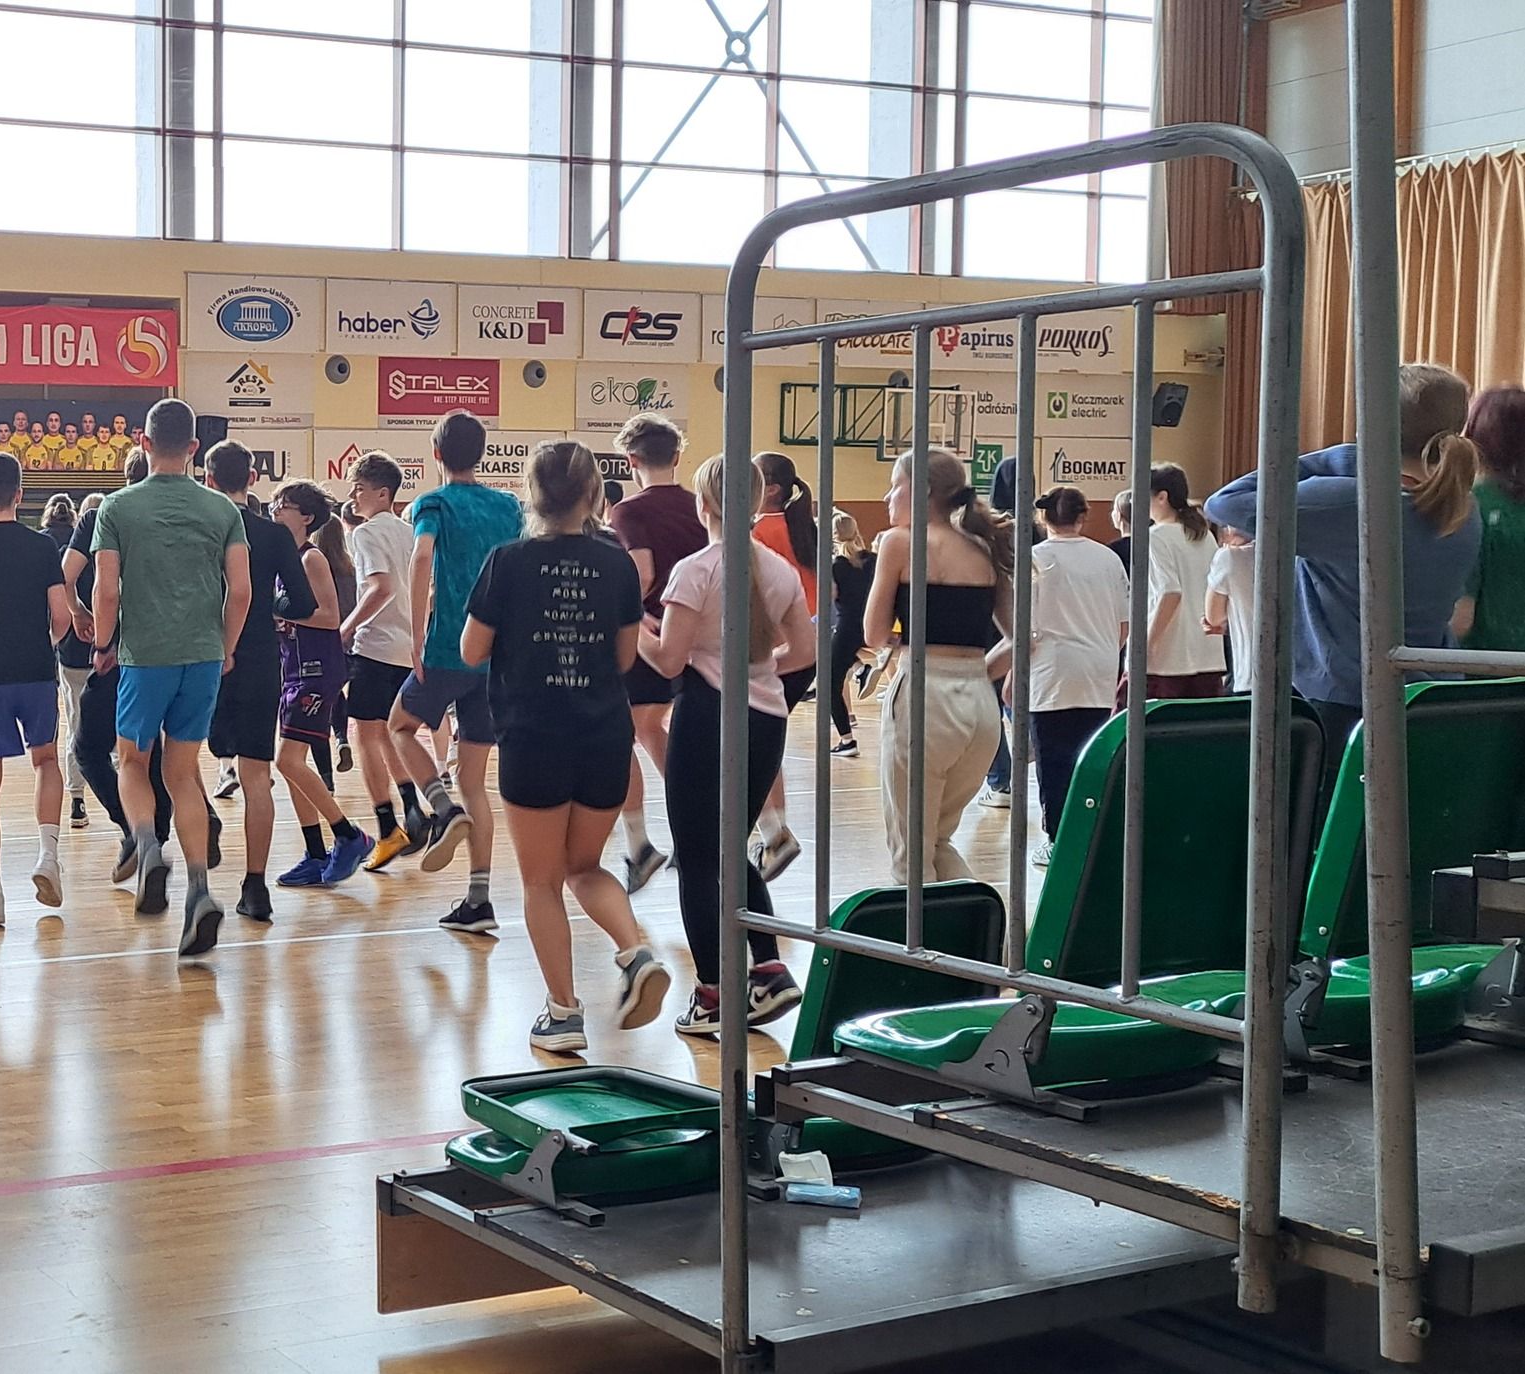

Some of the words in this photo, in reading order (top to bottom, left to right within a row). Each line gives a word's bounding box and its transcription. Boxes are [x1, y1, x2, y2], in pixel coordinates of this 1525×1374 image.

[472, 305, 536, 320] CONCRETE
[338, 310, 406, 333] haber
[600, 311, 683, 341] CRS
[478, 321, 524, 340] K&D
[22, 323, 99, 367] LIGA
[1038, 325, 1113, 357] PORKOS
[233, 374, 266, 394] GRESTA
[976, 391, 994, 403] lub
[1071, 394, 1125, 405] Kaczmarek
[1071, 407, 1108, 418] electric
[486, 444, 529, 457] SŁUGI
[1061, 460, 1127, 475] BOGMAT
